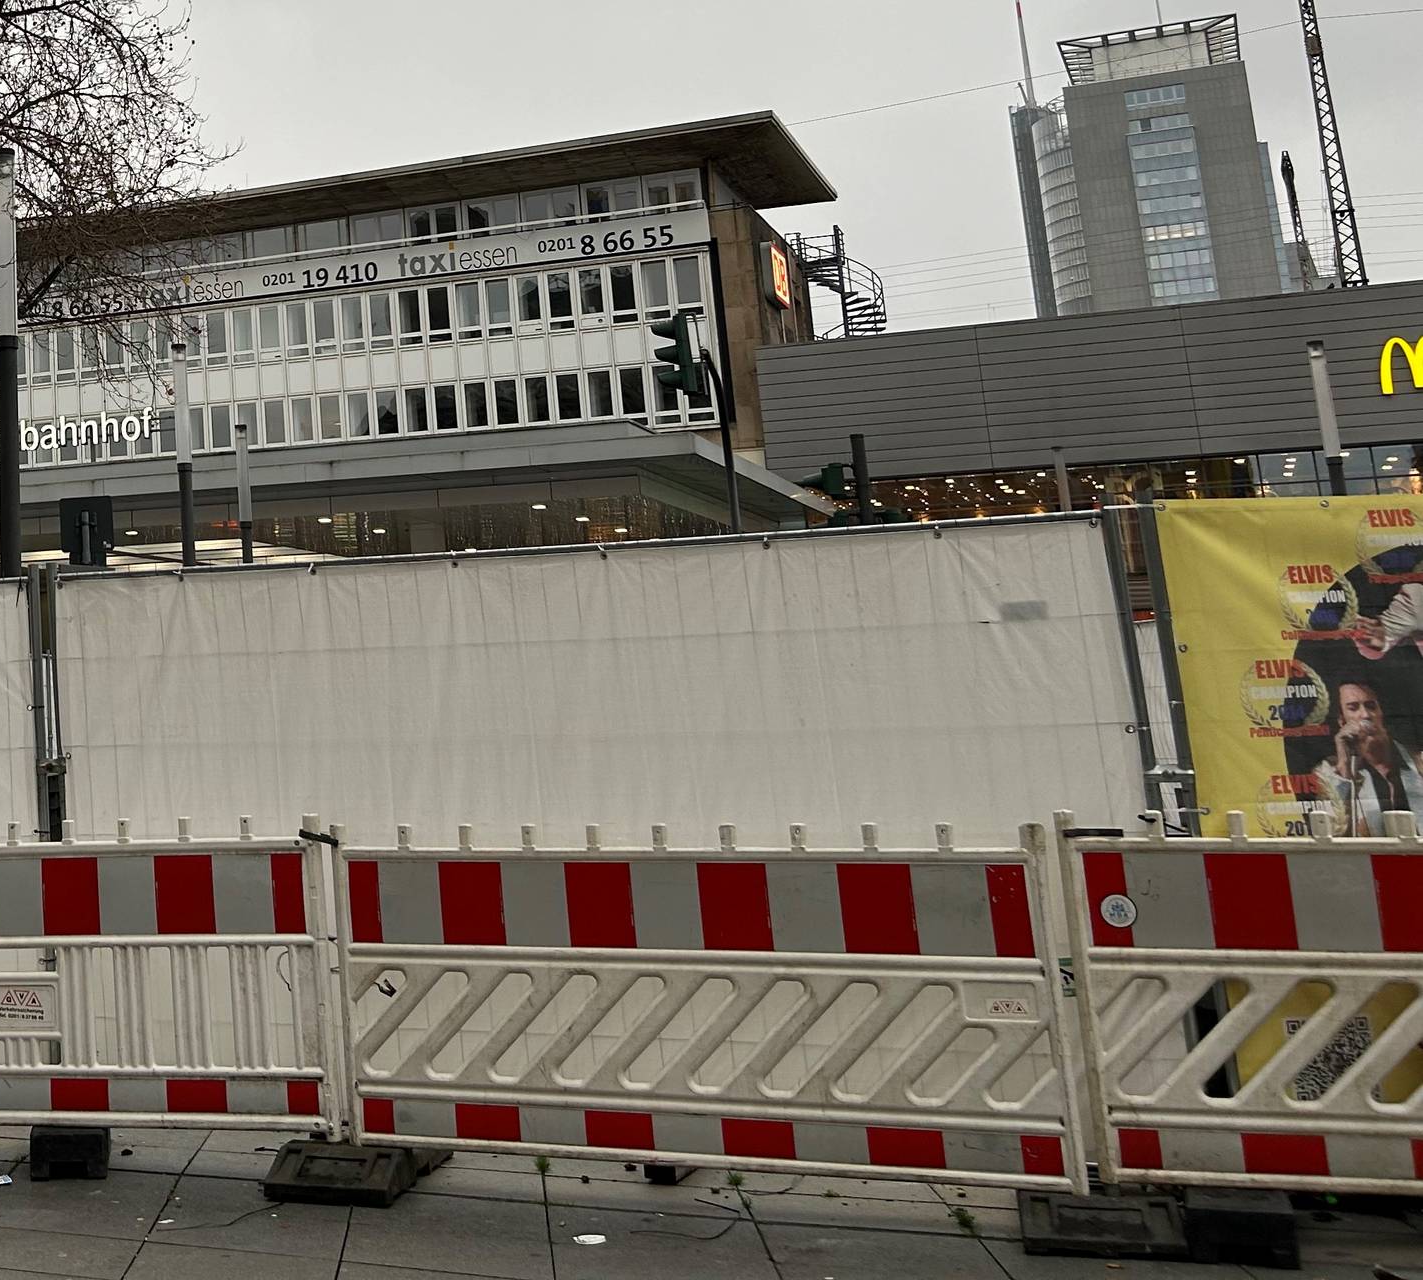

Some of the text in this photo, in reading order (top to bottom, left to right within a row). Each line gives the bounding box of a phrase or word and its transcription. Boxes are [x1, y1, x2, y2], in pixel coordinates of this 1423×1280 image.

[263, 272, 295, 287] 0201
[302, 267, 329, 289] 19
[335, 261, 378, 284] 410
[538, 236, 576, 254] 0201
[580, 234, 596, 256] 8
[603, 229, 635, 253] 66
[642, 224, 674, 249] 55
[1367, 508, 1415, 528] ELVIS
[1287, 564, 1334, 584] ELVIS
[1255, 659, 1309, 679] ELVIS
[1271, 774, 1320, 795] ELVIS
